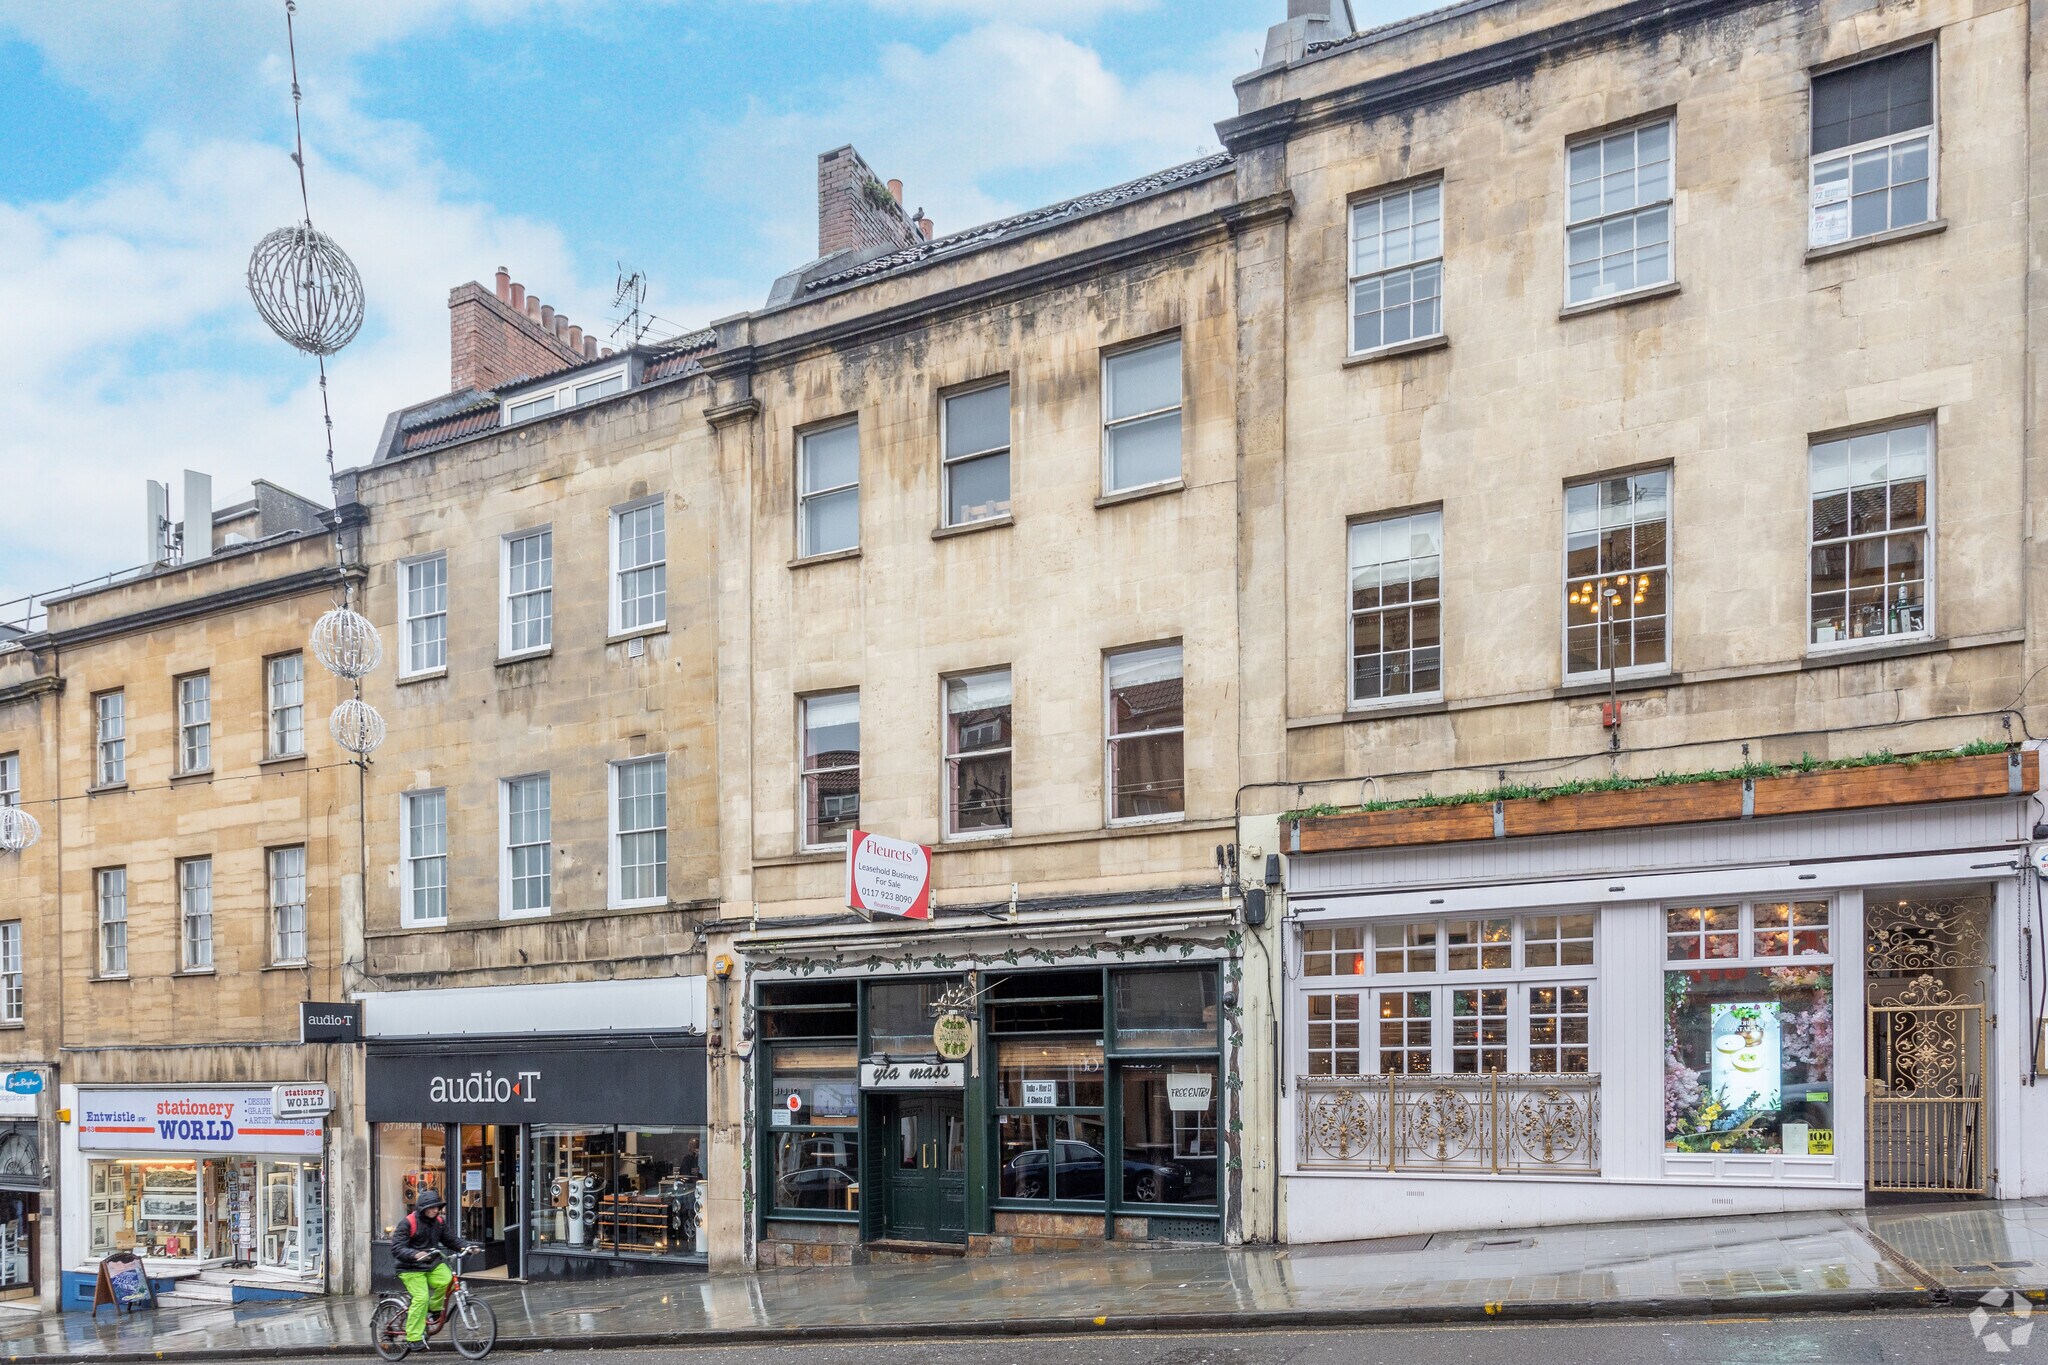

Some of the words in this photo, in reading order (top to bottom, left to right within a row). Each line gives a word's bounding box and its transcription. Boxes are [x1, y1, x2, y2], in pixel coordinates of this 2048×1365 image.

[866, 840, 912, 862] Fleurets
[858, 862, 890, 876] Leasehold
[891, 869, 919, 882] Business
[875, 876, 887, 886] For
[887, 879, 901, 889] Sale
[861, 887, 879, 898] 0117
[880, 890, 894, 901] 923
[894, 893, 912, 904] 8090
[873, 901, 901, 911] fleurets.com
[308, 1014, 341, 1026] audio
[909, 1065, 951, 1080] mass
[429, 1069, 512, 1103] audio
[284, 1088, 325, 1097] stationery
[1171, 1087, 1189, 1098] FREE
[1189, 1087, 1210, 1098] ENTRY
[248, 1098, 271, 1106] DESIGN
[286, 1097, 324, 1108] WORLD
[156, 1098, 235, 1119] stationery
[86, 1111, 136, 1123] Entwistle
[248, 1117, 272, 1125] ARTIST
[158, 1120, 234, 1141] WORLD
[305, 1129, 315, 1137] 63
[1809, 1131, 1832, 1141] 100
